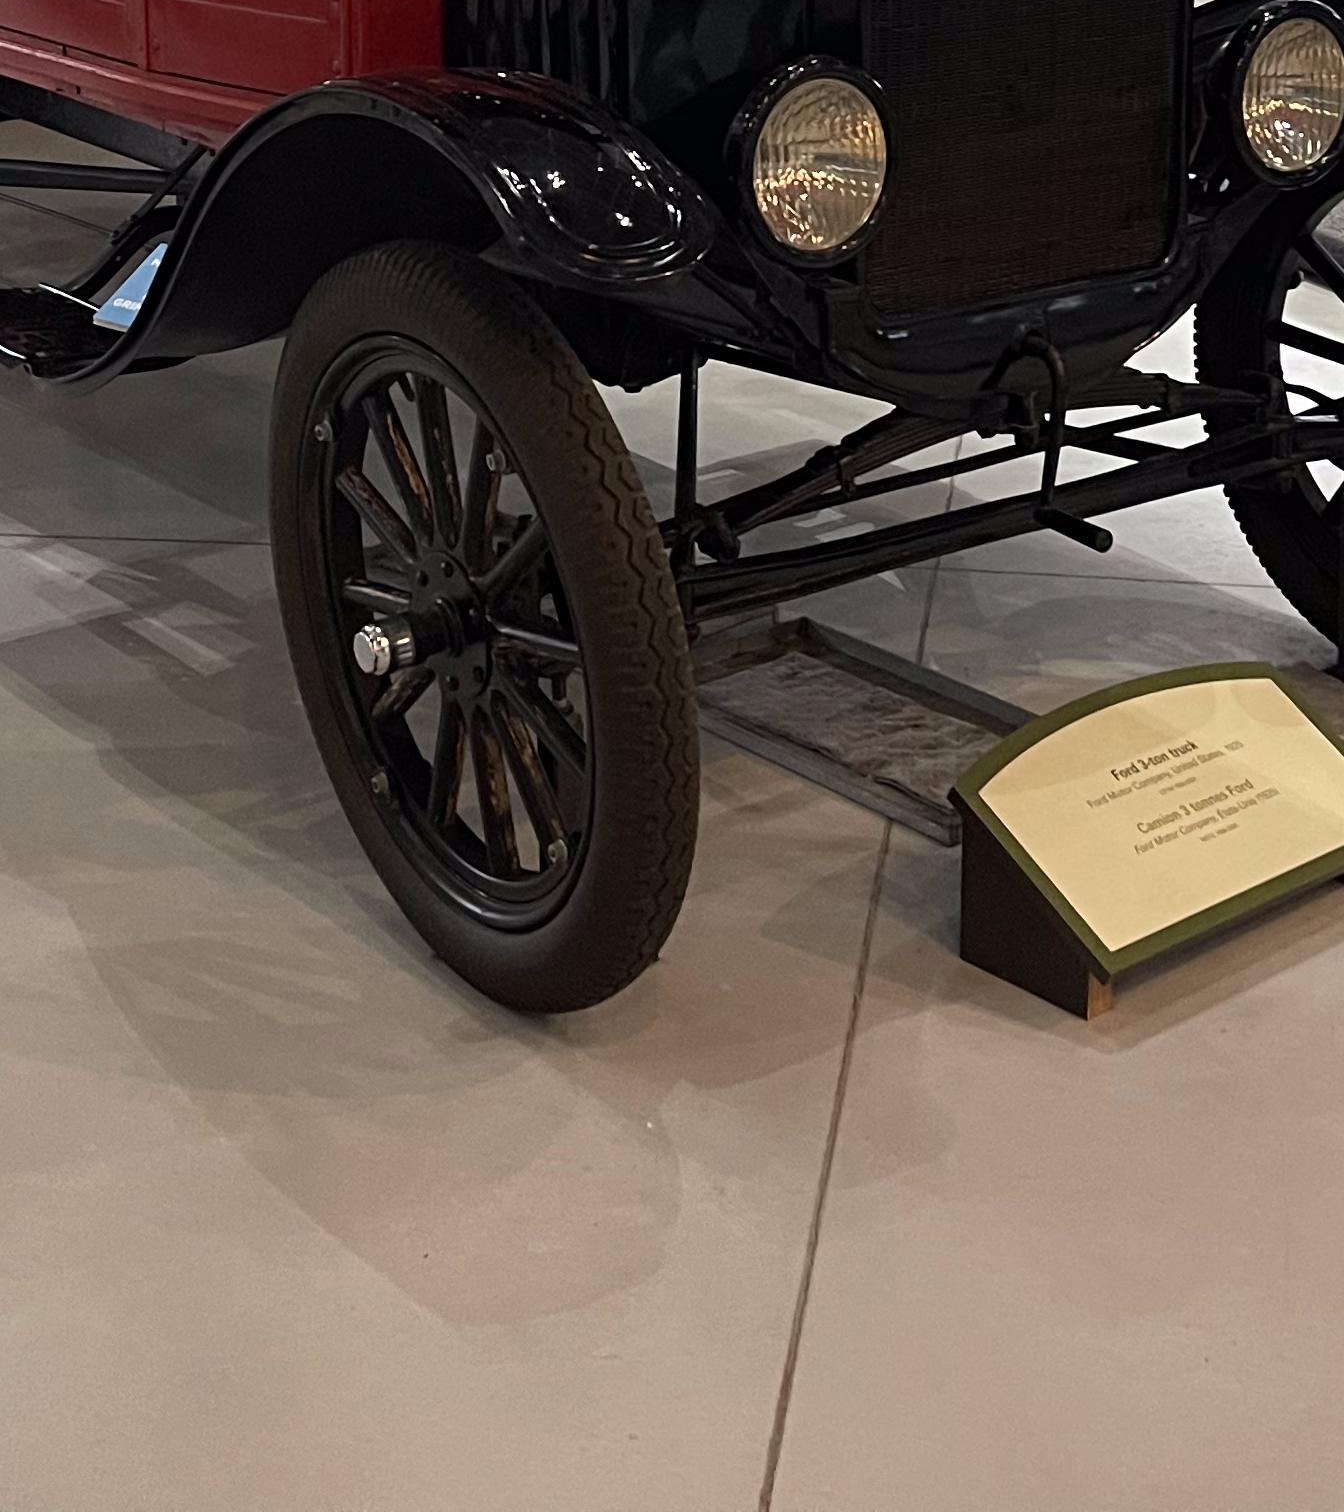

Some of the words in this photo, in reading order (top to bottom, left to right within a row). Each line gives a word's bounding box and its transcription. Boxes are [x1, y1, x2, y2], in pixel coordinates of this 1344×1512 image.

[1110, 762, 1140, 782] Ford
[1137, 752, 1170, 770] 3-ton
[1167, 739, 1199, 758] truck
[1136, 810, 1183, 834] Camion
[1178, 804, 1191, 817] 3
[1189, 791, 1229, 812] tonnes
[1225, 778, 1255, 796] Ford
